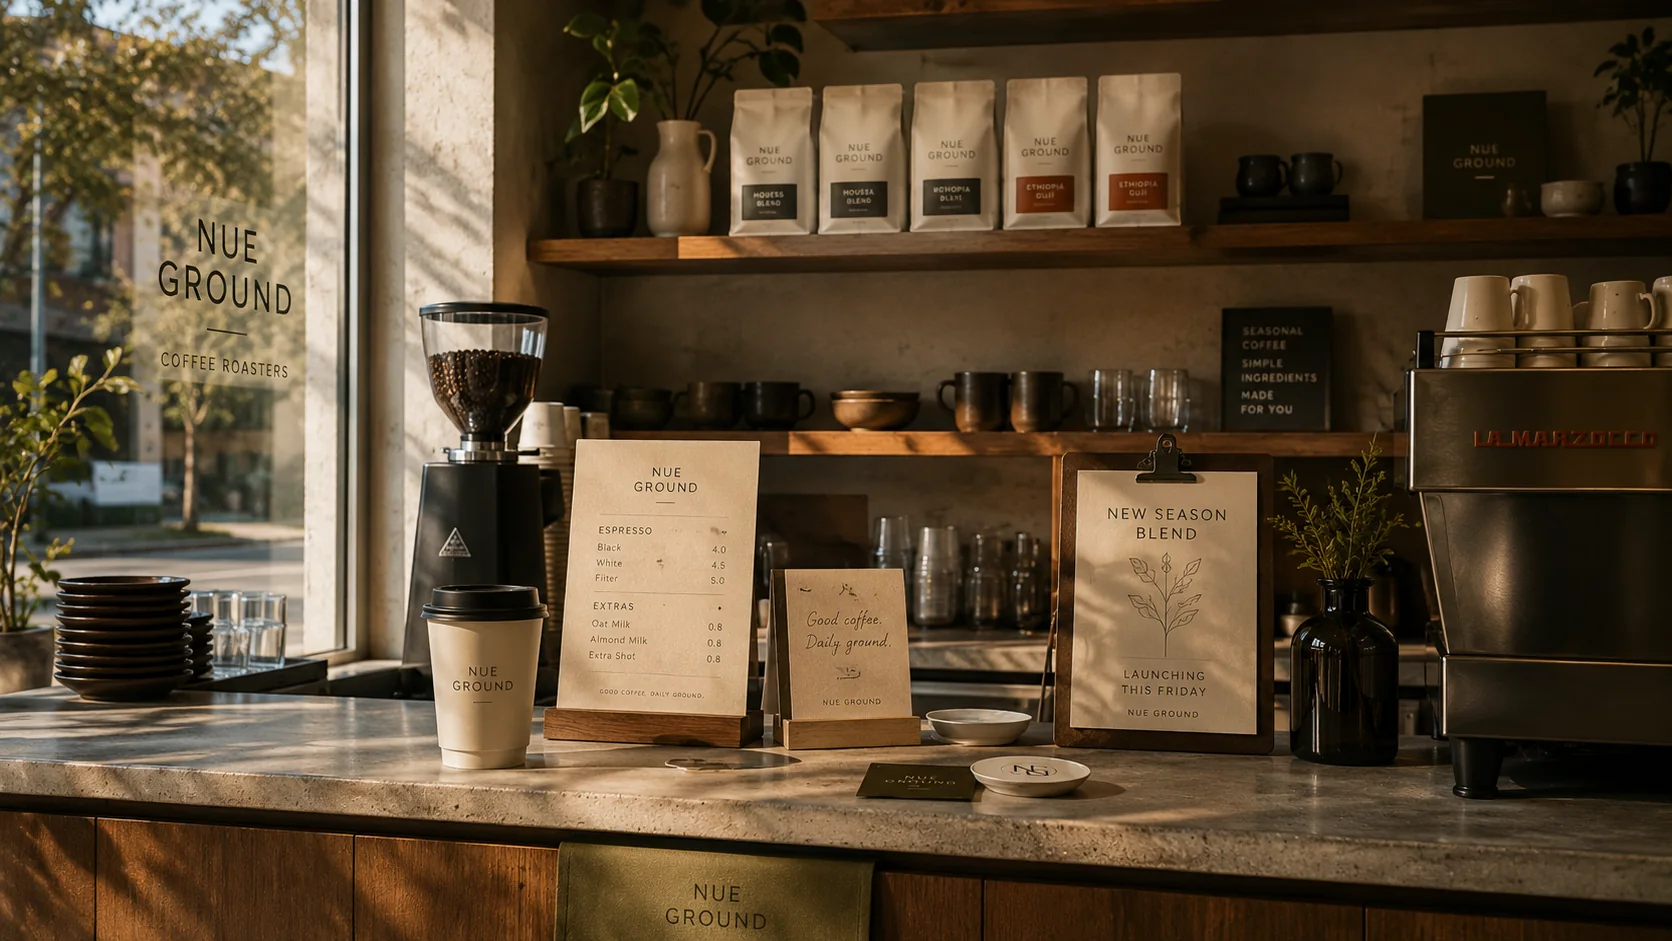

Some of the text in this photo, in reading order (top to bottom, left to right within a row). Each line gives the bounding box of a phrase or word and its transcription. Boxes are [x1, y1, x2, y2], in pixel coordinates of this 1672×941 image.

[1034, 138, 1056, 146] NUE
[1127, 134, 1150, 142] NUE
[848, 143, 870, 152] NUE
[941, 140, 963, 149] NUE
[1114, 144, 1162, 154] GROUND
[1470, 143, 1499, 155] NUE
[759, 146, 780, 154] NUE
[928, 150, 976, 160] GROUND
[1022, 148, 1069, 157] GROUND
[746, 156, 792, 166] GROUND
[836, 154, 882, 162] GROUND
[1453, 157, 1516, 169] GROUND
[198, 218, 257, 264] NUE
[158, 260, 292, 314] GROUND
[1242, 326, 1304, 336] SEASONAL
[1242, 340, 1286, 350] COFFEE
[161, 352, 288, 378] COFFEE ROASTERS
[1242, 359, 1283, 368] SIMPLE
[1241, 373, 1318, 382] INGREDIENTS
[1241, 390, 1274, 400] MADE
[1240, 404, 1293, 414] FOR YOU
[1474, 430, 1500, 448] LA
[652, 467, 682, 478] NUE
[634, 482, 698, 493] GROUND
[1107, 508, 1227, 521] NEW SEASON
[598, 526, 652, 535] ESPRESSO
[1136, 527, 1197, 540] BLEND
[598, 542, 726, 554] Black 4.0
[596, 559, 622, 568] White
[594, 602, 634, 610] EXTRAS
[807, 610, 882, 630] Good coffee.
[592, 619, 722, 632] Oat Milk 0.8
[590, 635, 722, 648] Almond Milk 0.8
[806, 632, 892, 656] Daily ground.
[588, 650, 720, 664] Extra Shot 0.8
[468, 666, 498, 676] NUE
[1124, 670, 1205, 681] LAUNCHING
[452, 680, 514, 692] GROUND
[1122, 684, 1206, 696] THIS FRIDAY
[1128, 709, 1199, 718] NUE GROUND
[694, 884, 740, 902] NUE
[666, 908, 766, 930] GROUND
